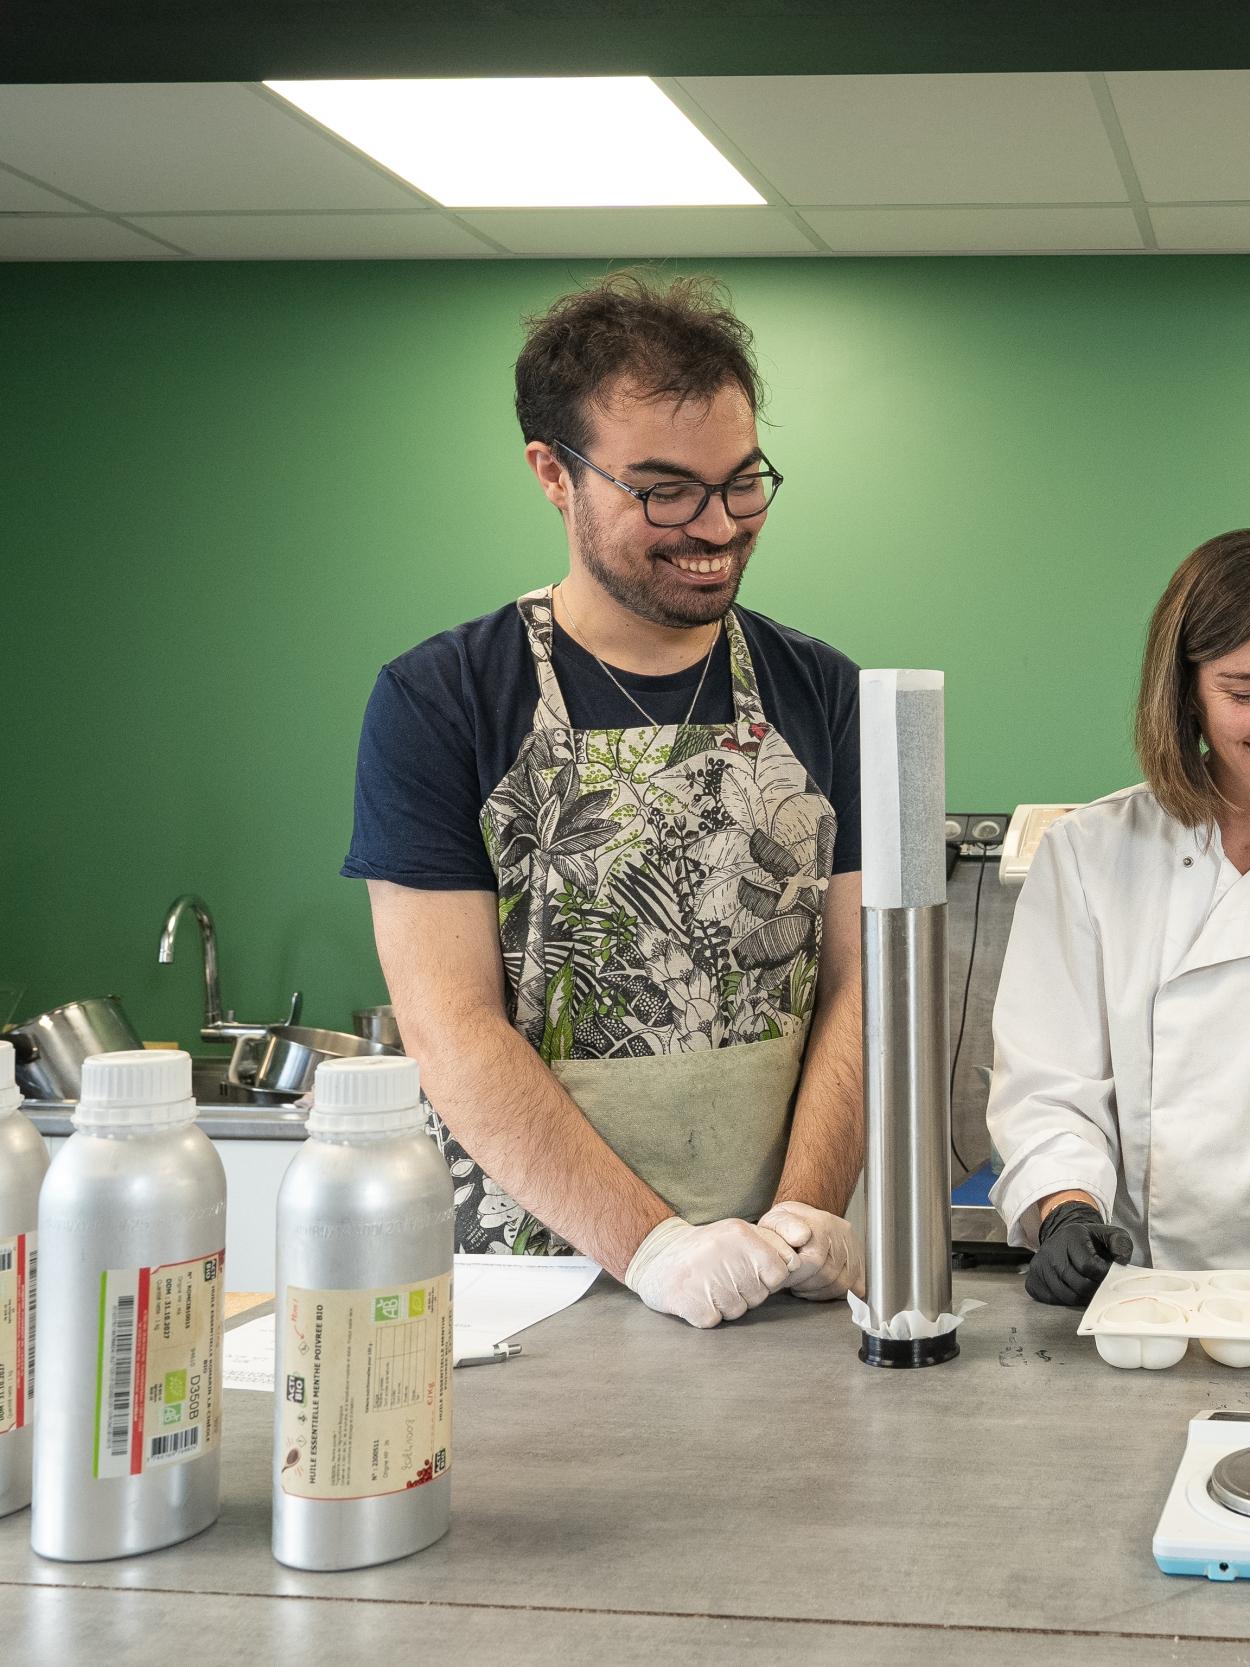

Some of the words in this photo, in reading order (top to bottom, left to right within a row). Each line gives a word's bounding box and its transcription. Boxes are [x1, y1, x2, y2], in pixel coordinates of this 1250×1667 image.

[315, 1304, 324, 1321] BIO
[314, 1322, 323, 1361] POIVREE
[287, 1375, 296, 1402] ACTI
[295, 1380, 304, 1401] BIO
[313, 1363, 321, 1398] MENTHE
[189, 1375, 201, 1420] D350B
[310, 1400, 320, 1456] ESSENTIELLE
[309, 1458, 318, 1484] HUILE
